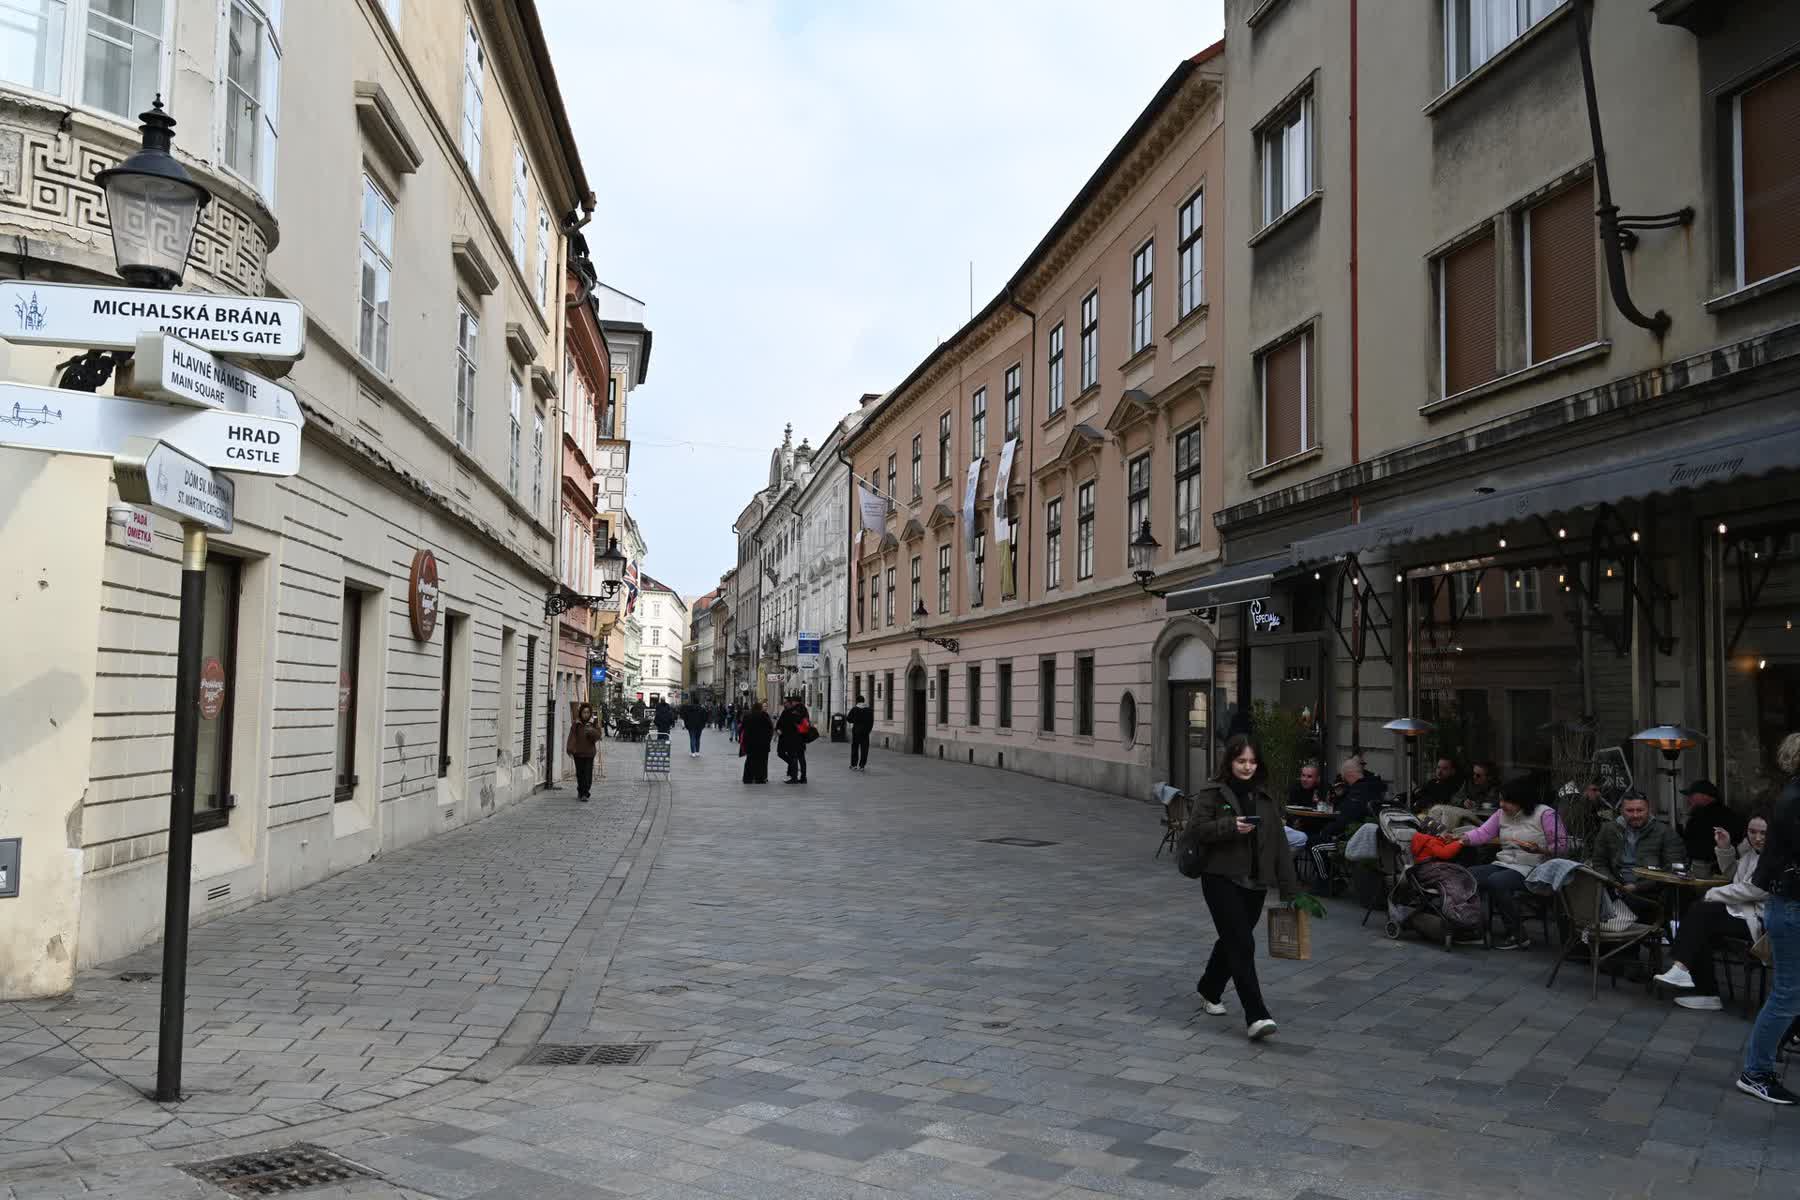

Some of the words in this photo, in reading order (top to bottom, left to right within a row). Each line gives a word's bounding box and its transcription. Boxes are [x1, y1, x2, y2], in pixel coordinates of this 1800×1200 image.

[93, 299, 209, 321] MICHALSKÁ
[215, 307, 282, 326] BRÁNA
[159, 325, 239, 341] MICHAEL'S
[243, 331, 281, 344] GATE
[172, 349, 212, 380] HLAVNÉ
[213, 367, 257, 399] NÁMESTIE
[171, 371, 193, 391] MAIN
[194, 382, 225, 404] SQUARE
[228, 425, 280, 445] HRAD
[226, 447, 280, 463] CASTLE
